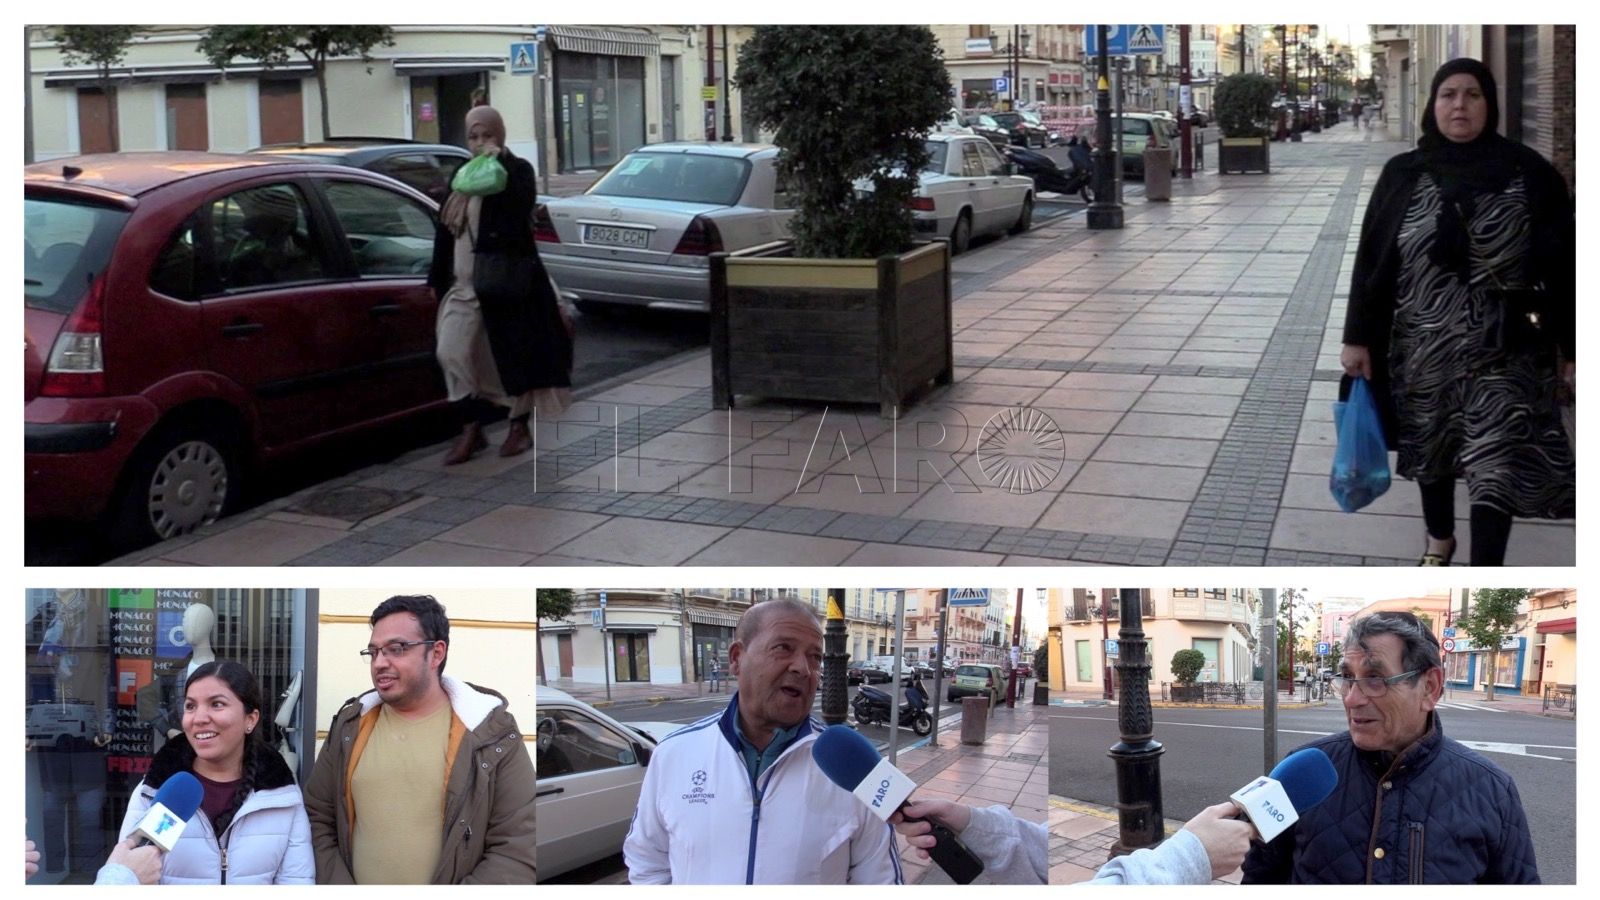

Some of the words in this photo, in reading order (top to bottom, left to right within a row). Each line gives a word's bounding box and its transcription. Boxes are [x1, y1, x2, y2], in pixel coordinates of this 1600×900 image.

[996, 80, 1008, 92] P
[591, 227, 620, 241] 9028
[623, 230, 645, 243] CCH
[157, 589, 202, 599] MONACO
[109, 611, 153, 620] MONACO
[107, 743, 151, 752] MONACO
[108, 756, 152, 773] FRI
[872, 780, 890, 808] FARO
[1262, 800, 1285, 822] FARO
